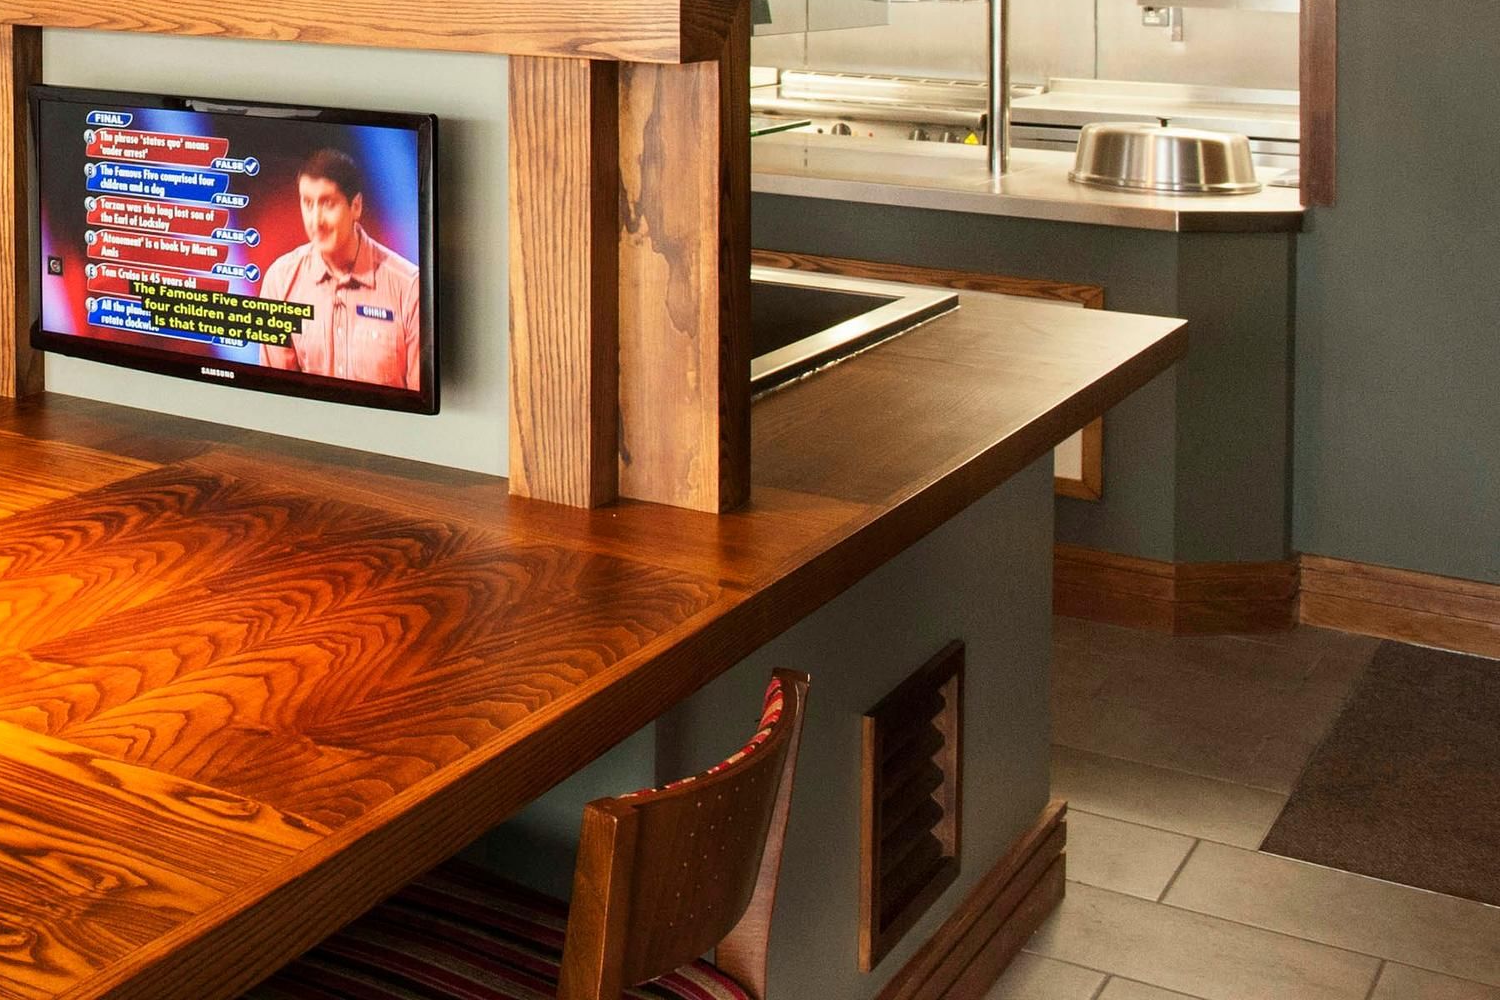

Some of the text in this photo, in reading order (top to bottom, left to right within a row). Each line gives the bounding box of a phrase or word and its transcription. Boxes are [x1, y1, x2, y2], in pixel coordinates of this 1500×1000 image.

[95, 113, 124, 124] FINAL
[100, 131, 113, 141] The
[114, 132, 139, 145] phrase
[184, 141, 209, 151] means
[215, 160, 244, 170] FALSE
[100, 164, 215, 186] The Famous Five comprised four
[100, 177, 165, 197] children and a dog
[215, 195, 245, 205] FALSE
[100, 199, 214, 221] Tarzan was the long lost son of
[101, 211, 112, 223] the
[129, 215, 138, 226] of
[216, 230, 245, 241] FALSE
[153, 241, 159, 249] a
[160, 239, 179, 252] book
[180, 241, 190, 256] by
[191, 243, 218, 257] Martin
[101, 266, 117, 277] Tom
[118, 268, 140, 280] Cruise
[149, 273, 160, 284] 45
[184, 277, 197, 289] old
[216, 265, 245, 276] FALSE
[113, 301, 126, 312] the
[133, 282, 311, 317] The Famous Five comprised
[145, 298, 297, 333] four children and a dog.
[155, 315, 287, 345] Is that true or false?
[201, 367, 235, 379] SAMSUNG
